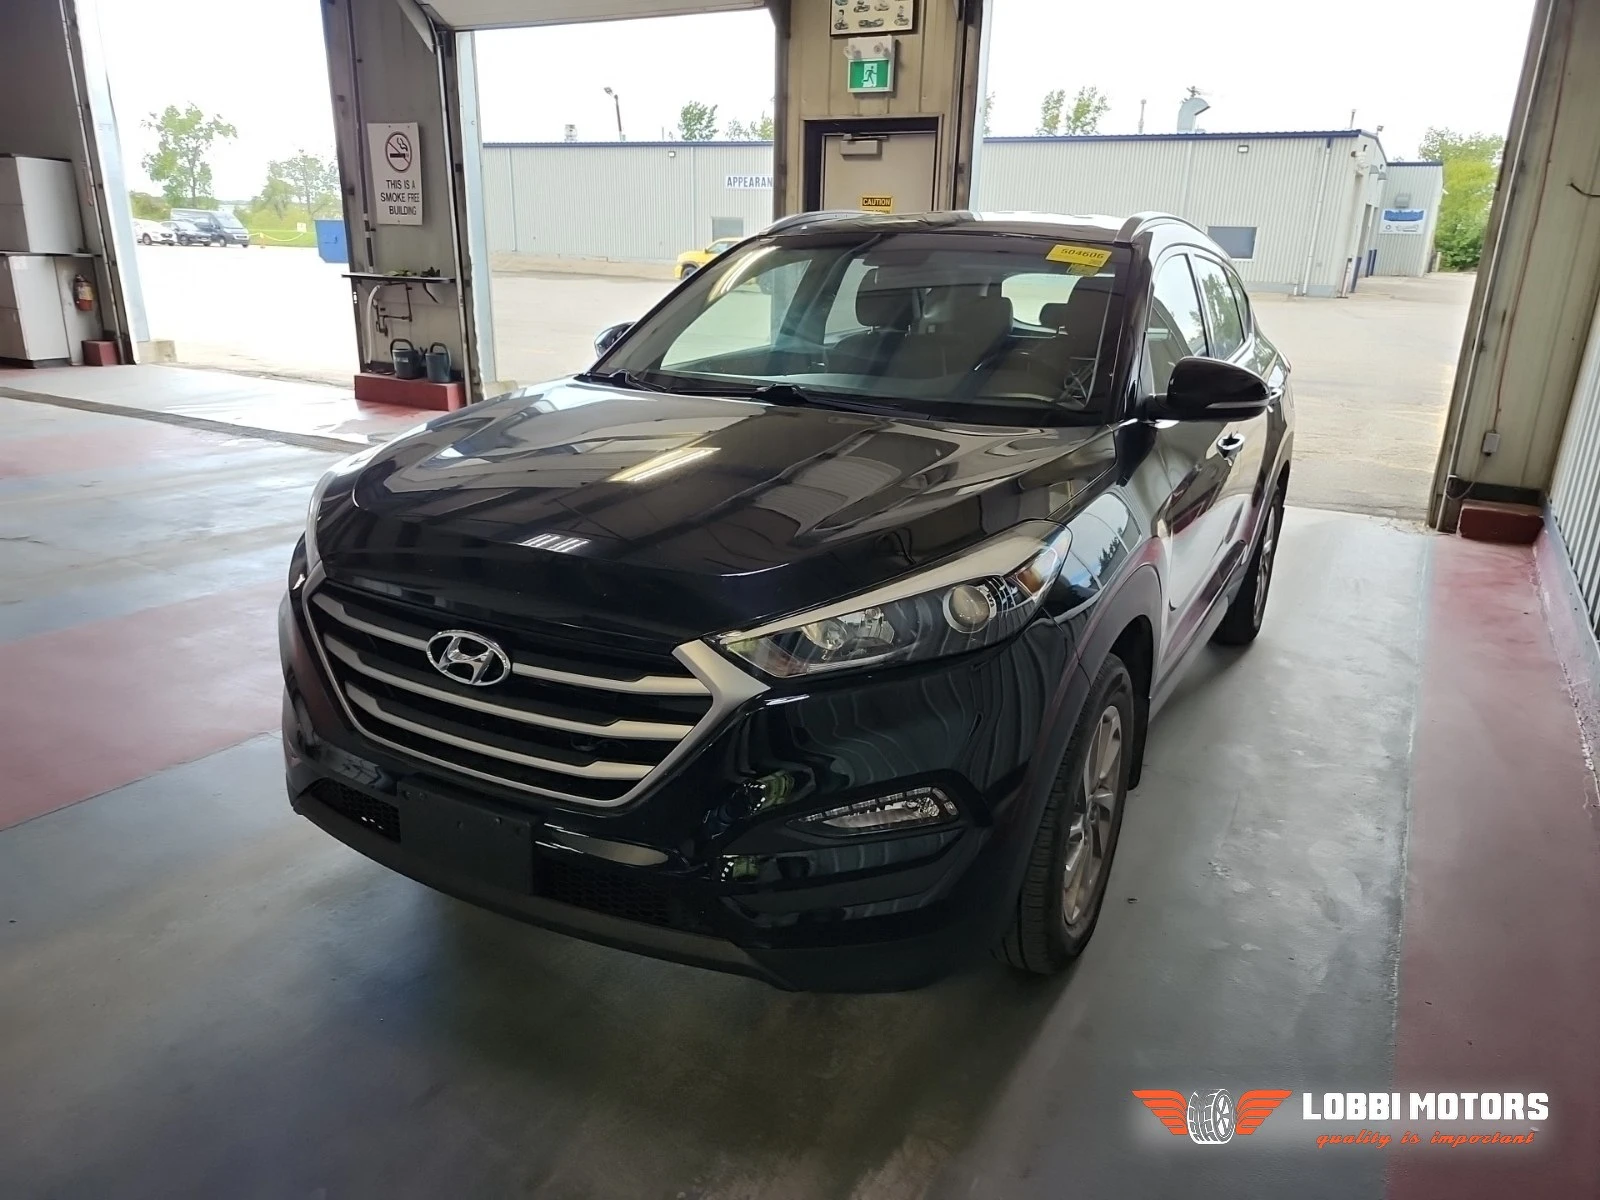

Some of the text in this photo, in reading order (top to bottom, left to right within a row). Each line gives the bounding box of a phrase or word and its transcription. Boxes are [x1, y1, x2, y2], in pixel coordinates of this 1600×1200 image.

[386, 180, 416, 189] THIS IS A
[380, 192, 420, 202] SMOKE FREE
[863, 198, 891, 206] CAUTION
[389, 205, 417, 215] BUILDING
[1060, 248, 1104, 259] 504606
